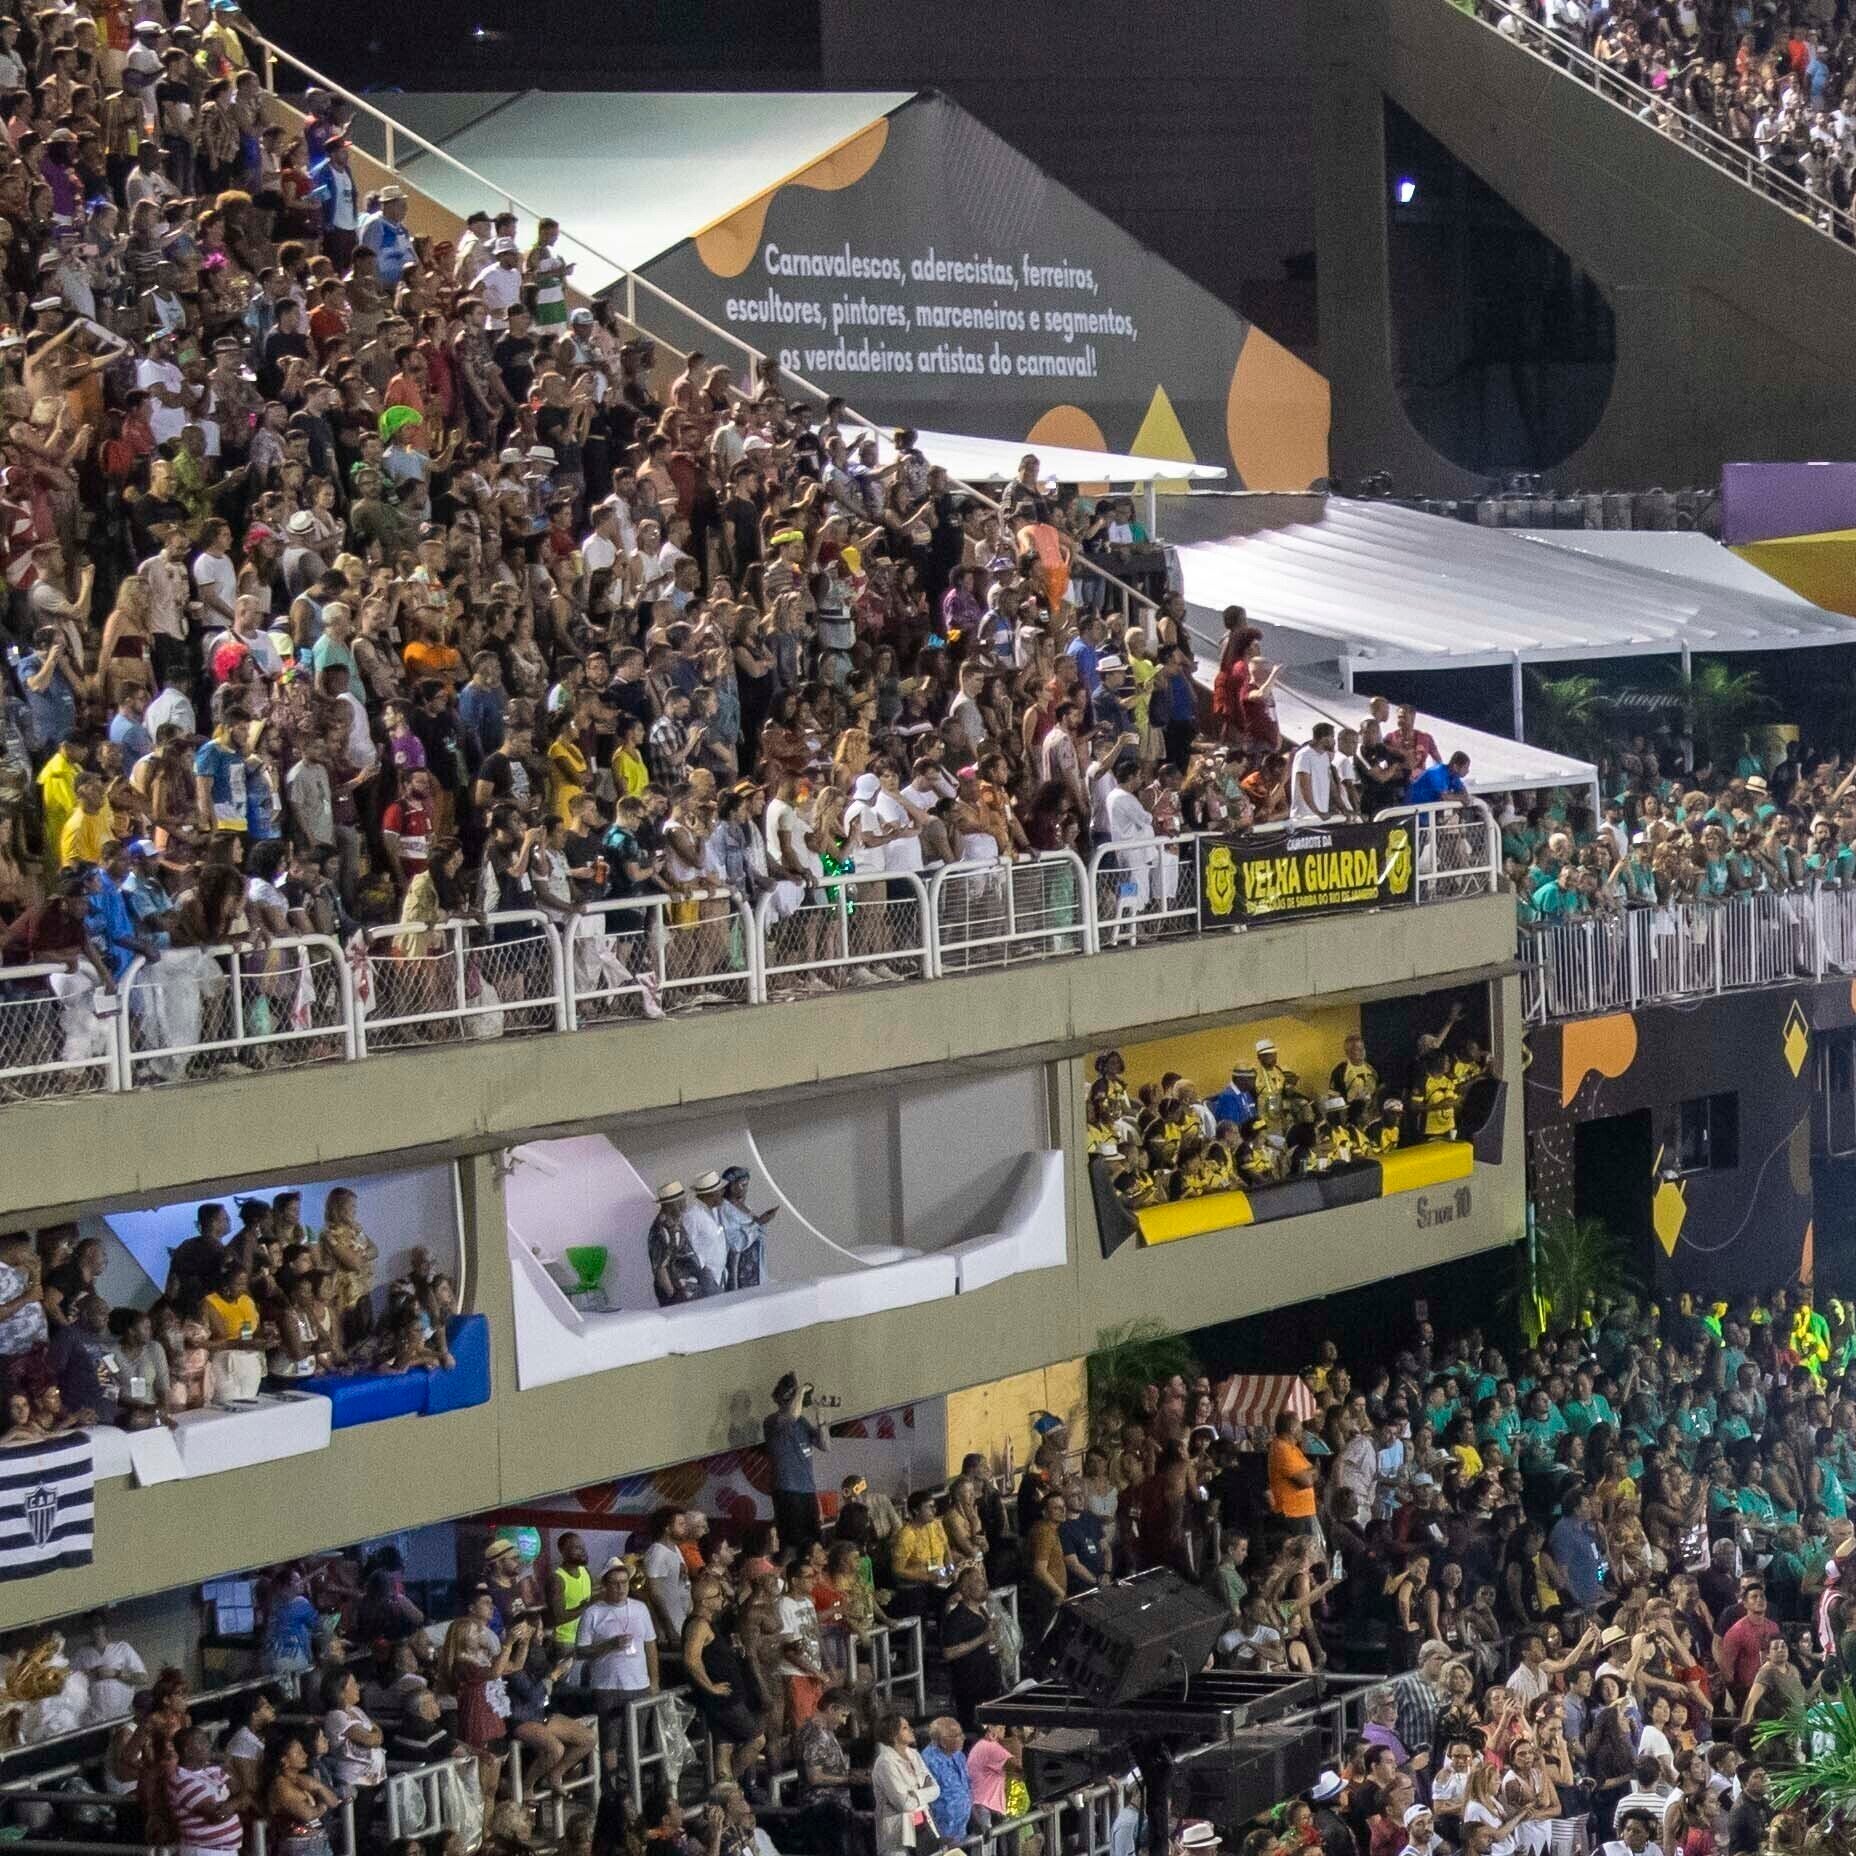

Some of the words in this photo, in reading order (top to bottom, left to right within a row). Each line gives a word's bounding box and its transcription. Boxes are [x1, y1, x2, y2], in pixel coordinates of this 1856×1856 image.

[764, 242, 906, 286] Carnavalescos,
[911, 247, 1019, 292] aderecistas,
[1022, 253, 1099, 294] ferreiros,
[726, 287, 827, 330] escultores,
[832, 295, 911, 336] pintores,
[915, 300, 1026, 332] marceneiros
[1029, 309, 1040, 332] e
[1044, 307, 1138, 342] segmentos,
[779, 346, 801, 372] os
[804, 337, 914, 373] verdadeiros
[918, 344, 984, 374] artistas
[990, 341, 1011, 375] do
[1015, 344, 1098, 377] carnaval!
[1242, 856, 1301, 899] VELHA
[1304, 848, 1378, 892] GUARDA
